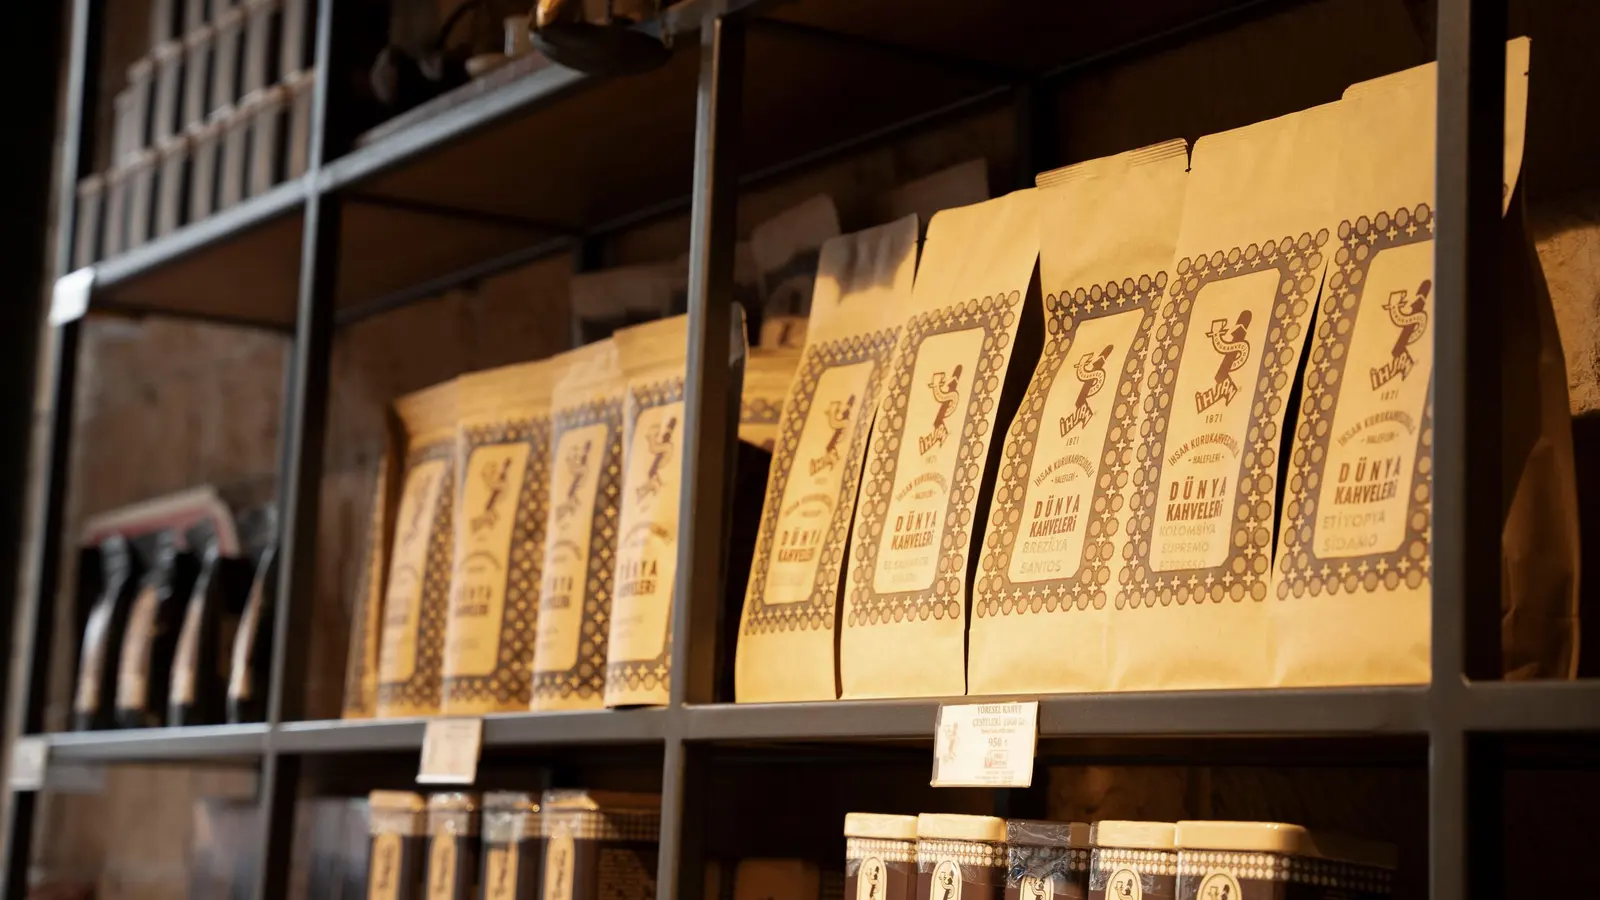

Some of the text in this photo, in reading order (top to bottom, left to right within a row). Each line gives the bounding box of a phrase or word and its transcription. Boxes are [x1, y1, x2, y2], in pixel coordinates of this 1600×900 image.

[1205, 413, 1224, 424] 1871
[1167, 440, 1190, 466] İHSAN
[1033, 464, 1053, 487] İHSAN
[1338, 456, 1401, 483] DÜNYA
[1169, 475, 1227, 501] DÜNYA
[1334, 478, 1399, 505] KAHVELERİ
[1034, 494, 1081, 519] DÜNYA
[1166, 499, 1225, 521] KAHVELERİ
[895, 509, 938, 532] DÜNYA
[1029, 515, 1078, 538] KAHVELERİ
[1158, 521, 1217, 537] KOLOMBİYA
[1323, 509, 1386, 530] ETİYOPYA
[891, 529, 935, 551] KAHVELERİ
[1022, 537, 1068, 554] BREZİLYA
[1161, 541, 1210, 554] SUPREMO
[1019, 559, 1062, 575] SANTOS
[988, 737, 1003, 748] 950
